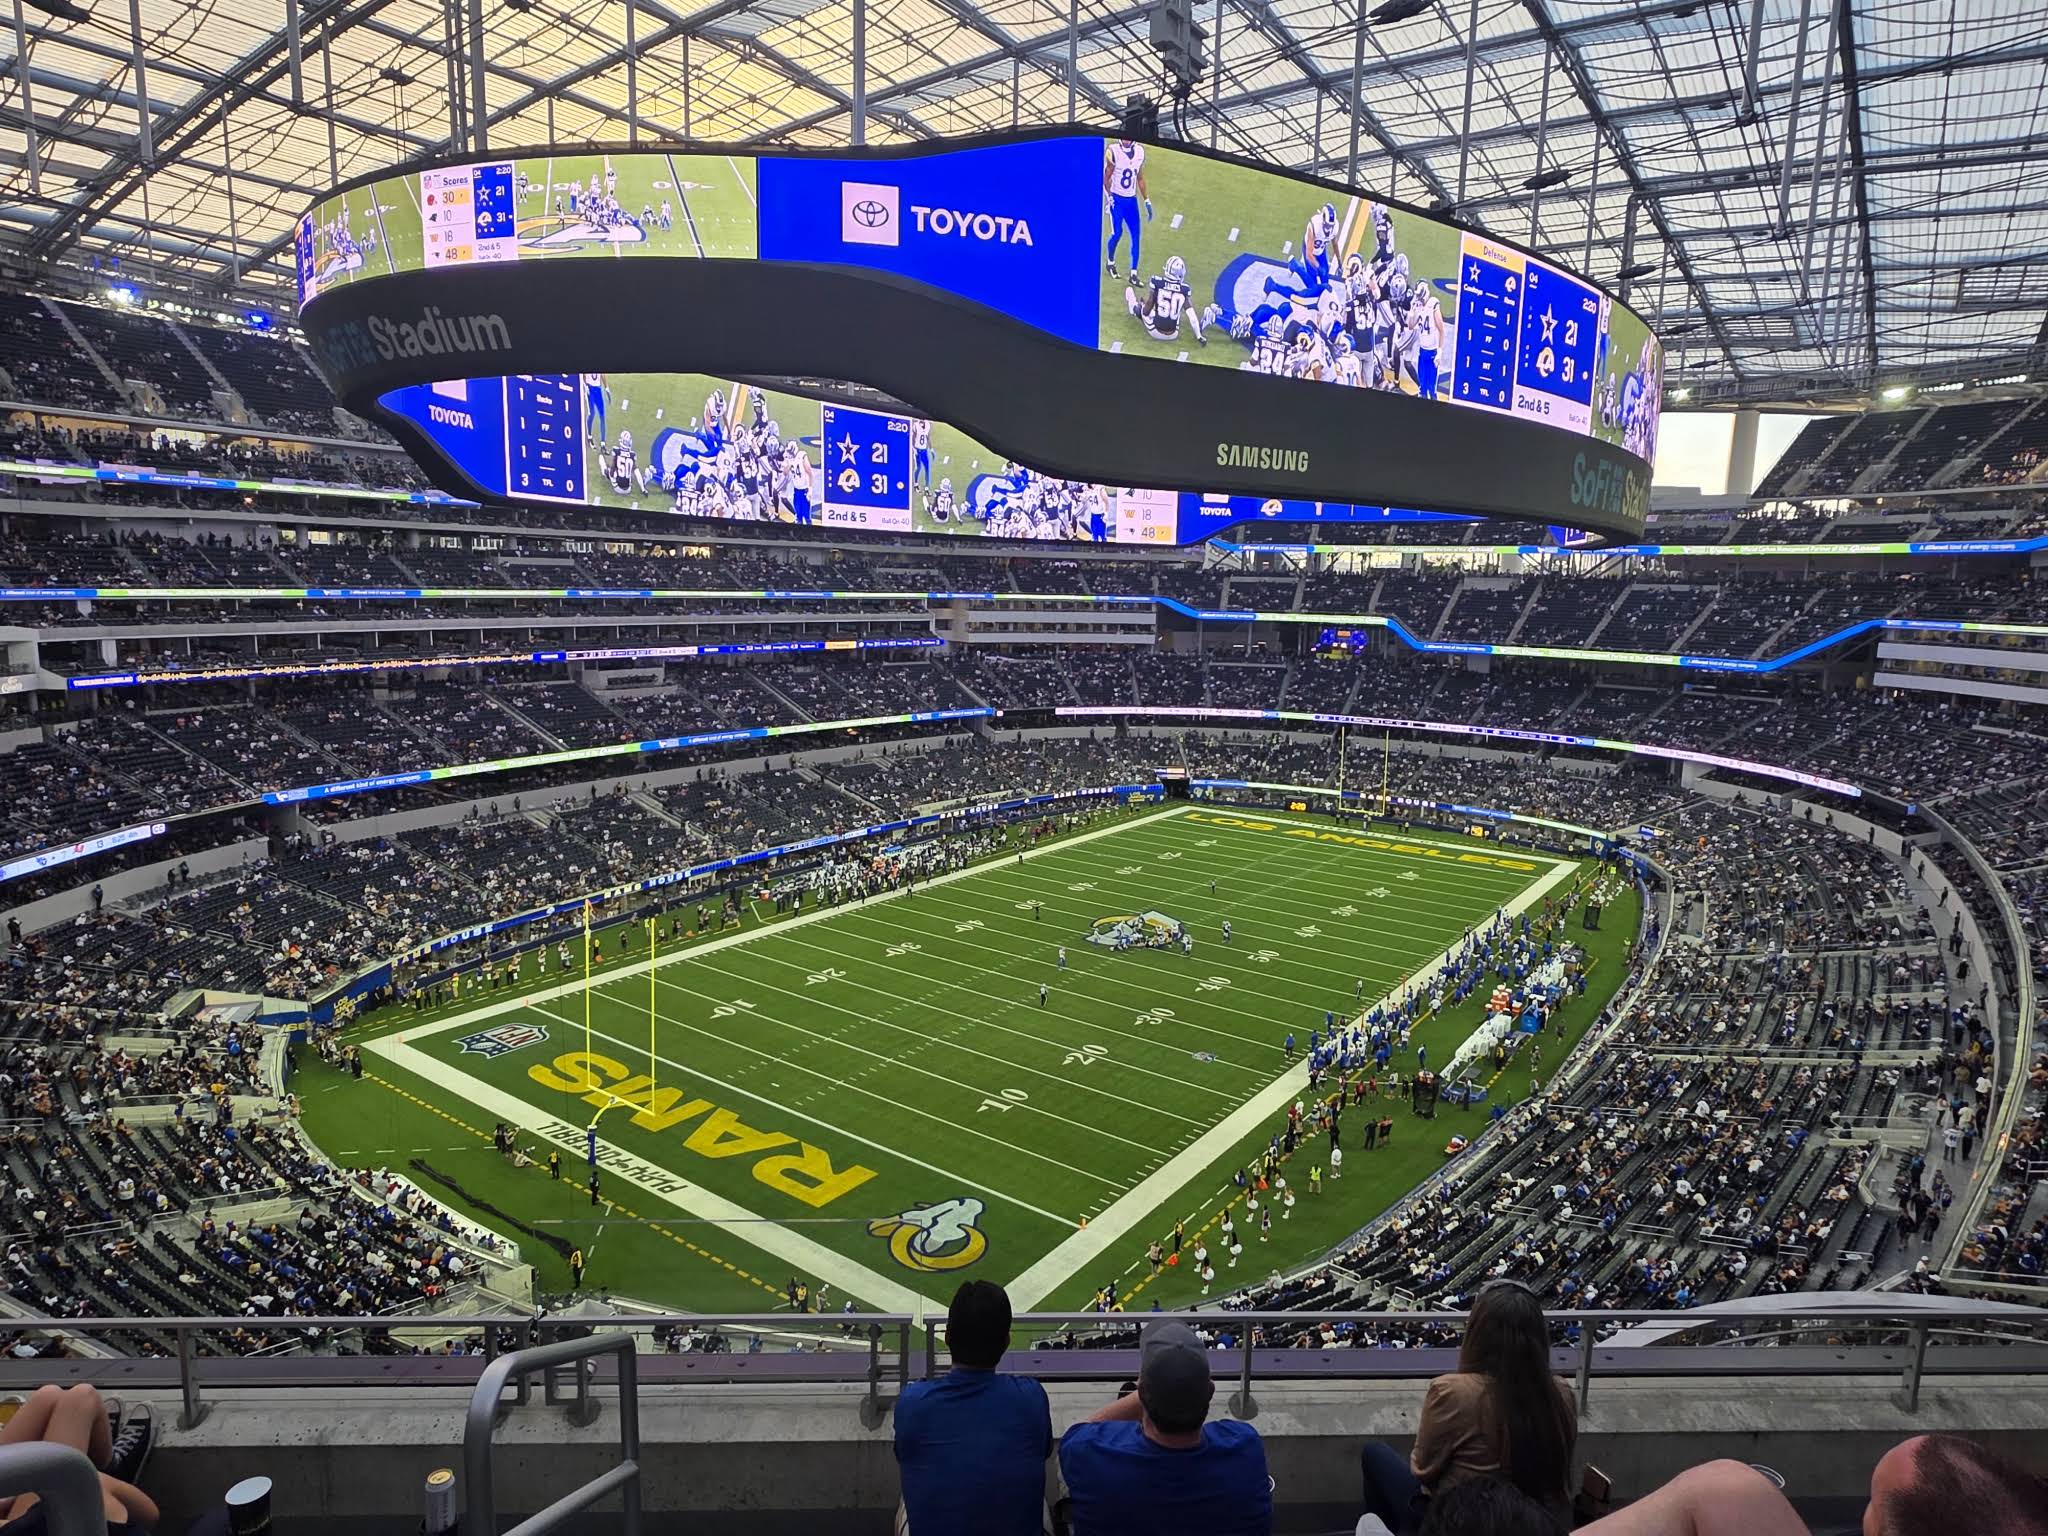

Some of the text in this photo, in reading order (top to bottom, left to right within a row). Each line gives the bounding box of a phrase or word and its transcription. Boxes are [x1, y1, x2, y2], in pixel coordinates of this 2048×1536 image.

[496, 167, 512, 175] 2:20
[443, 177, 468, 186] Scores
[442, 191, 454, 204] 30
[496, 186, 505, 196] 21
[444, 210, 452, 221] 10
[496, 212, 506, 222] 31
[911, 205, 1033, 246] TOYOTA
[444, 230, 454, 242] 18
[446, 248, 458, 260] 48
[1483, 245, 1507, 263] Defense
[1157, 289, 1184, 320] 50
[367, 306, 513, 361] Stadium
[1565, 319, 1578, 347] 21
[1502, 338, 1510, 351] 0
[1562, 356, 1575, 383] 31
[1462, 382, 1469, 394] 3
[1498, 390, 1505, 403] 0
[1518, 394, 1550, 414] 2nd & 5
[428, 404, 474, 430] TOYOTA
[564, 426, 572, 439] 0
[888, 421, 908, 433] 2:20
[872, 442, 888, 464] 21
[1216, 443, 1309, 473] SAMSUNG
[616, 458, 632, 478] 50
[521, 473, 528, 486] 3
[566, 480, 574, 492] 0
[871, 474, 888, 495] 31
[828, 510, 867, 523] 2nd & 5
[1142, 508, 1152, 521] 18
[1200, 506, 1232, 517] TOYOTA
[900, 518, 910, 526] 40
[1141, 526, 1156, 538] 48
[330, 782, 355, 792] different
[356, 781, 368, 789] kind
[376, 778, 395, 786] energy
[1184, 813, 1278, 832] LOS
[1282, 828, 1537, 872] ANGELES
[604, 870, 691, 898] RAMS HOUSE
[957, 918, 984, 932] 40
[392, 925, 493, 968] RAMS HOUSE
[890, 942, 922, 956] 30
[1248, 949, 1280, 962] 50
[806, 967, 846, 985] 20
[1198, 976, 1232, 992] 40
[713, 998, 757, 1017] 10
[1136, 1007, 1176, 1025] 30
[491, 1026, 541, 1047] NFL
[1066, 1044, 1108, 1066] 20
[982, 1088, 1029, 1113] 10
[527, 1051, 879, 1208] RAMS
[621, 1165, 689, 1194] PLAY
